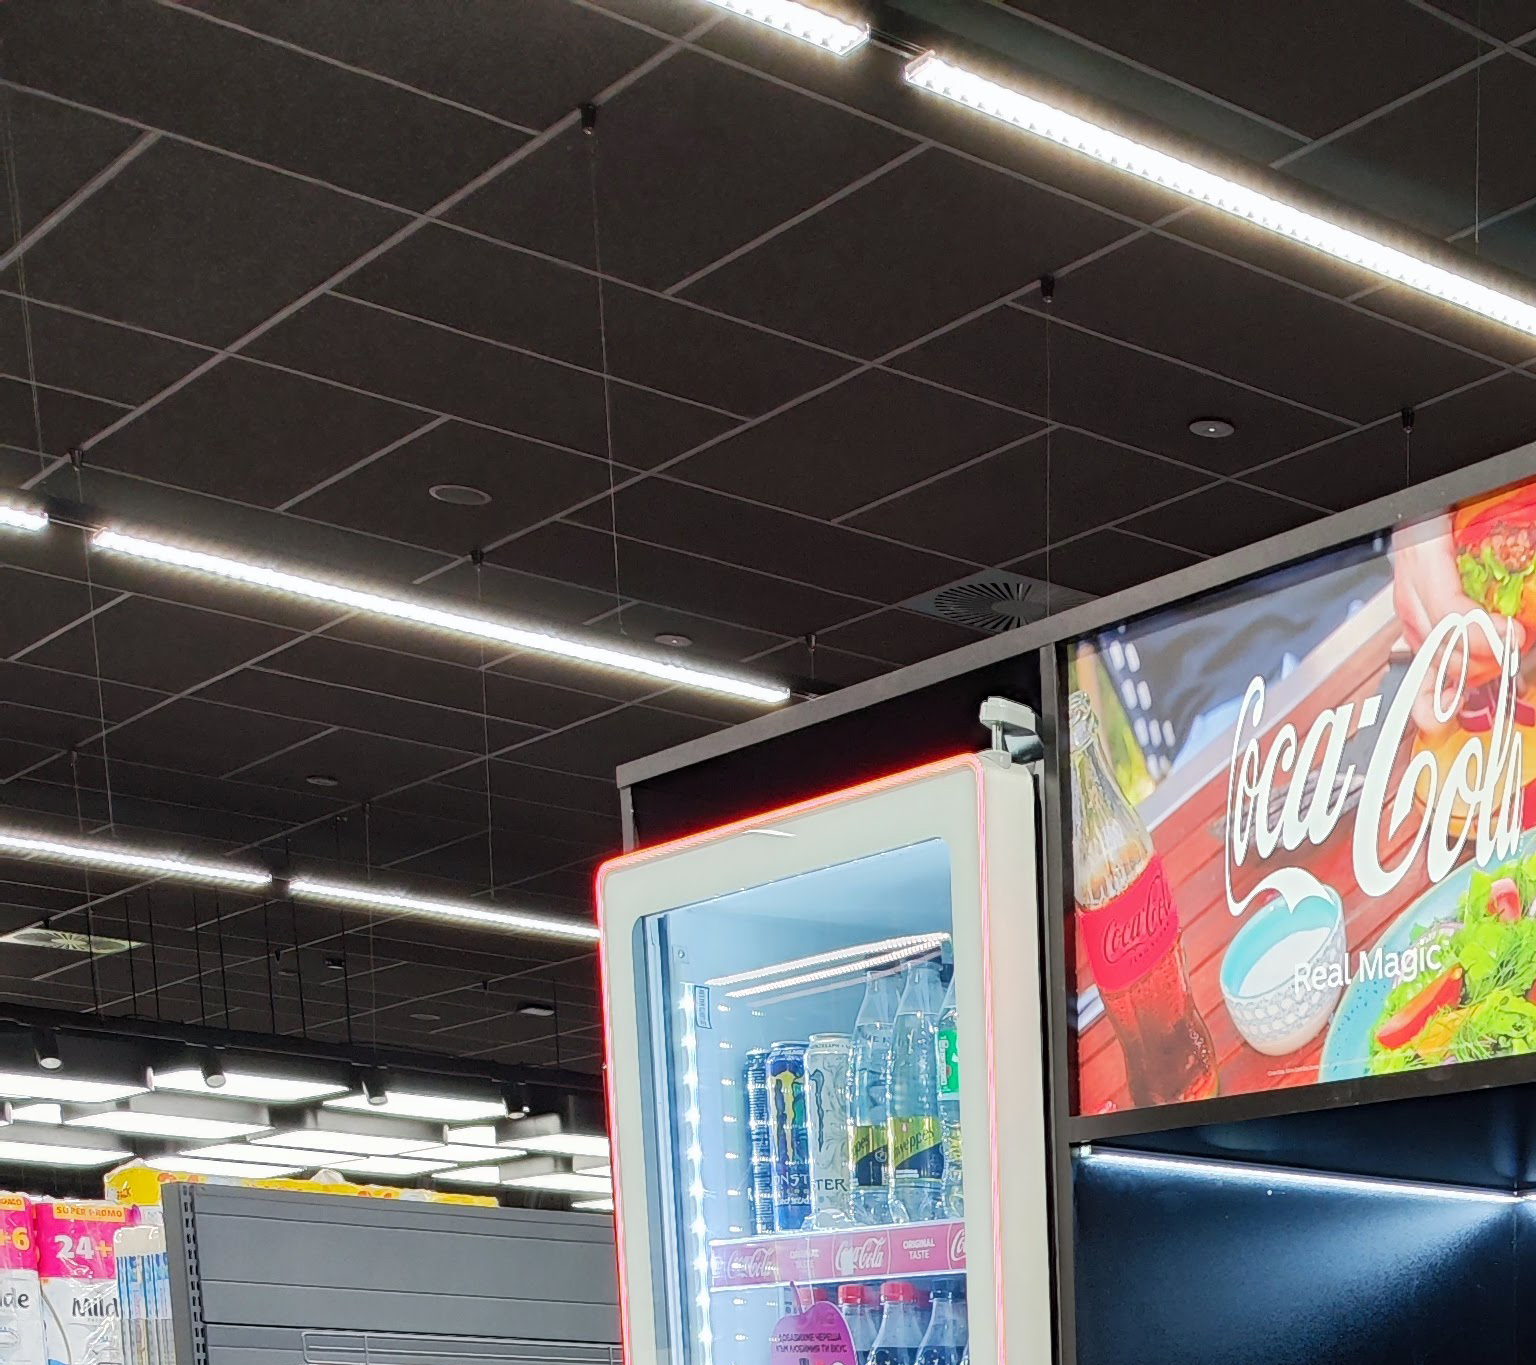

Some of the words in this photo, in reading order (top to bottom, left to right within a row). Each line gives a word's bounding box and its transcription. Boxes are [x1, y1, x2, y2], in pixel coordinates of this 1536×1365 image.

[1225, 608, 1524, 917] Coca-Cola
[1294, 952, 1351, 994] Real
[1359, 944, 1442, 983] Magic
[903, 1238, 936, 1250] ORIGINAL
[908, 1249, 930, 1260] TASTE
[72, 1297, 120, 1318] Mild
